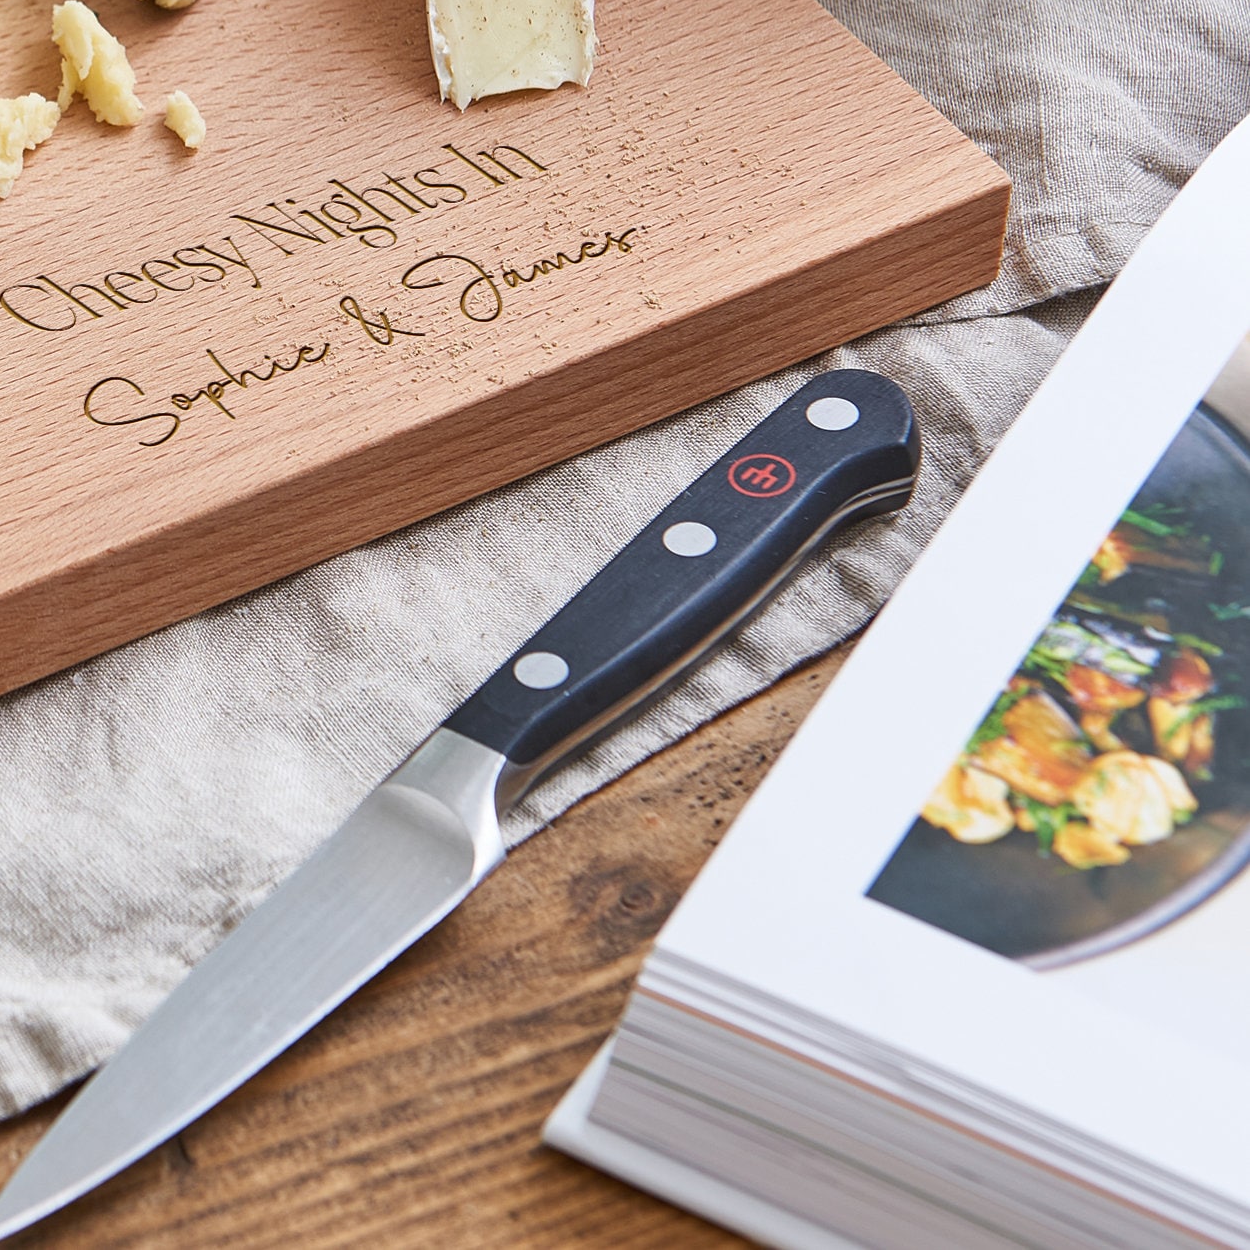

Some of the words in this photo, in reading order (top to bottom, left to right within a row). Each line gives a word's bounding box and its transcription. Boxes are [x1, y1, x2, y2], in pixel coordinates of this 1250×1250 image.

[0, 235, 262, 332] Cheesy
[229, 168, 468, 249] Nights
[441, 143, 548, 188] In
[83, 343, 331, 447] Sophie
[339, 295, 426, 346] &
[401, 227, 637, 323] James
